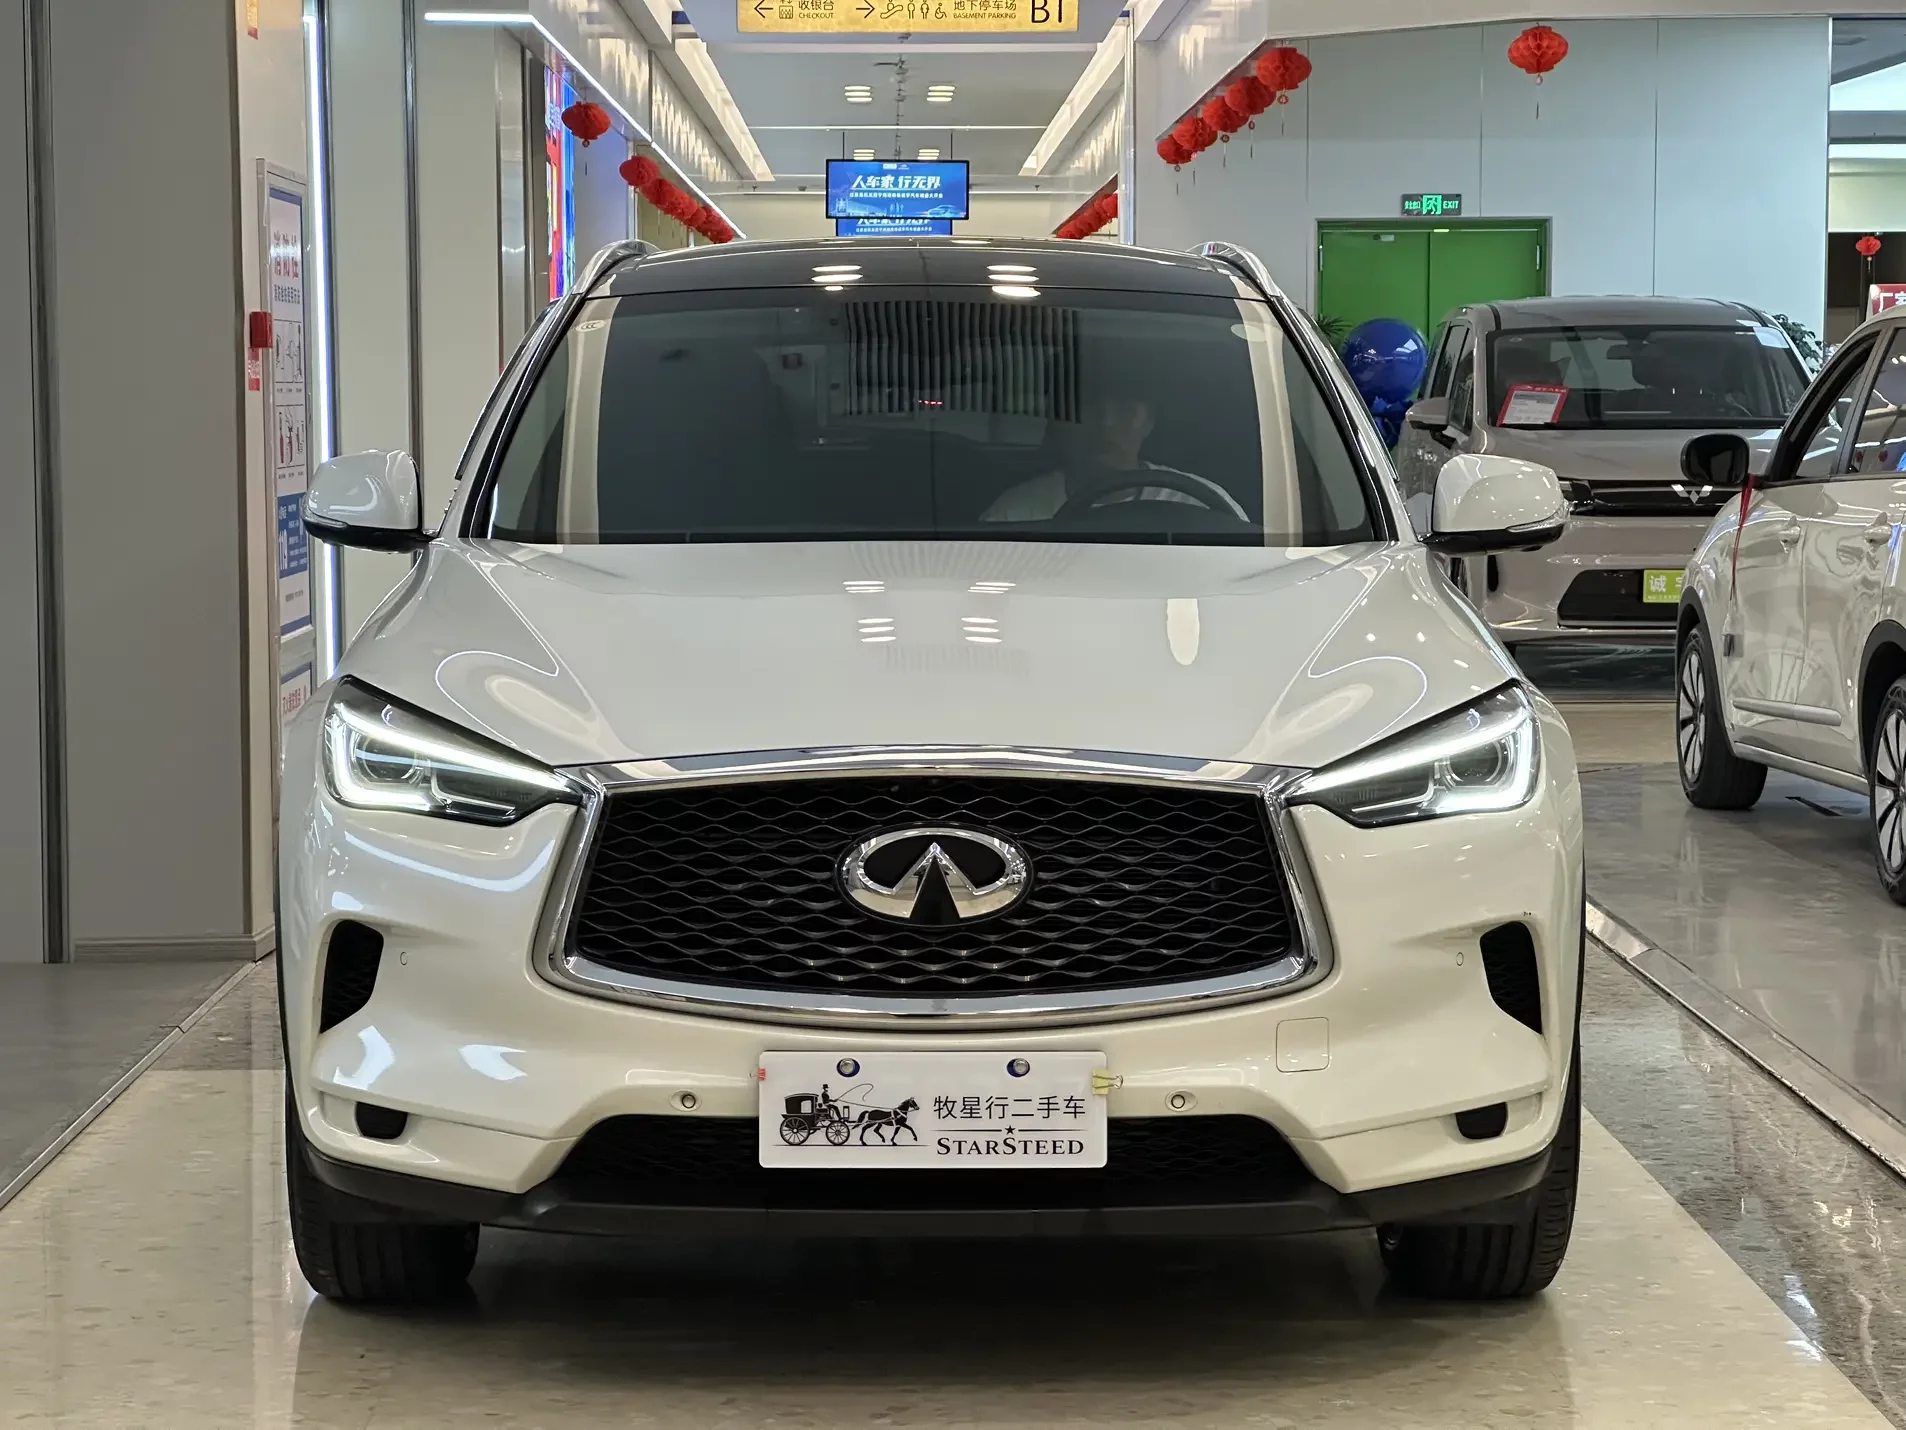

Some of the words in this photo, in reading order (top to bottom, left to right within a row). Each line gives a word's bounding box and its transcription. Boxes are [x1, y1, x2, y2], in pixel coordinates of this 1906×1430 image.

[798, 0, 834, 11] 收银台
[953, 0, 1017, 11] 地下停车场
[851, 174, 895, 189] 人车家
[898, 175, 941, 189] 行无界
[1443, 200, 1459, 209] EXIT
[933, 1095, 1086, 1120] 牧星行二手车
